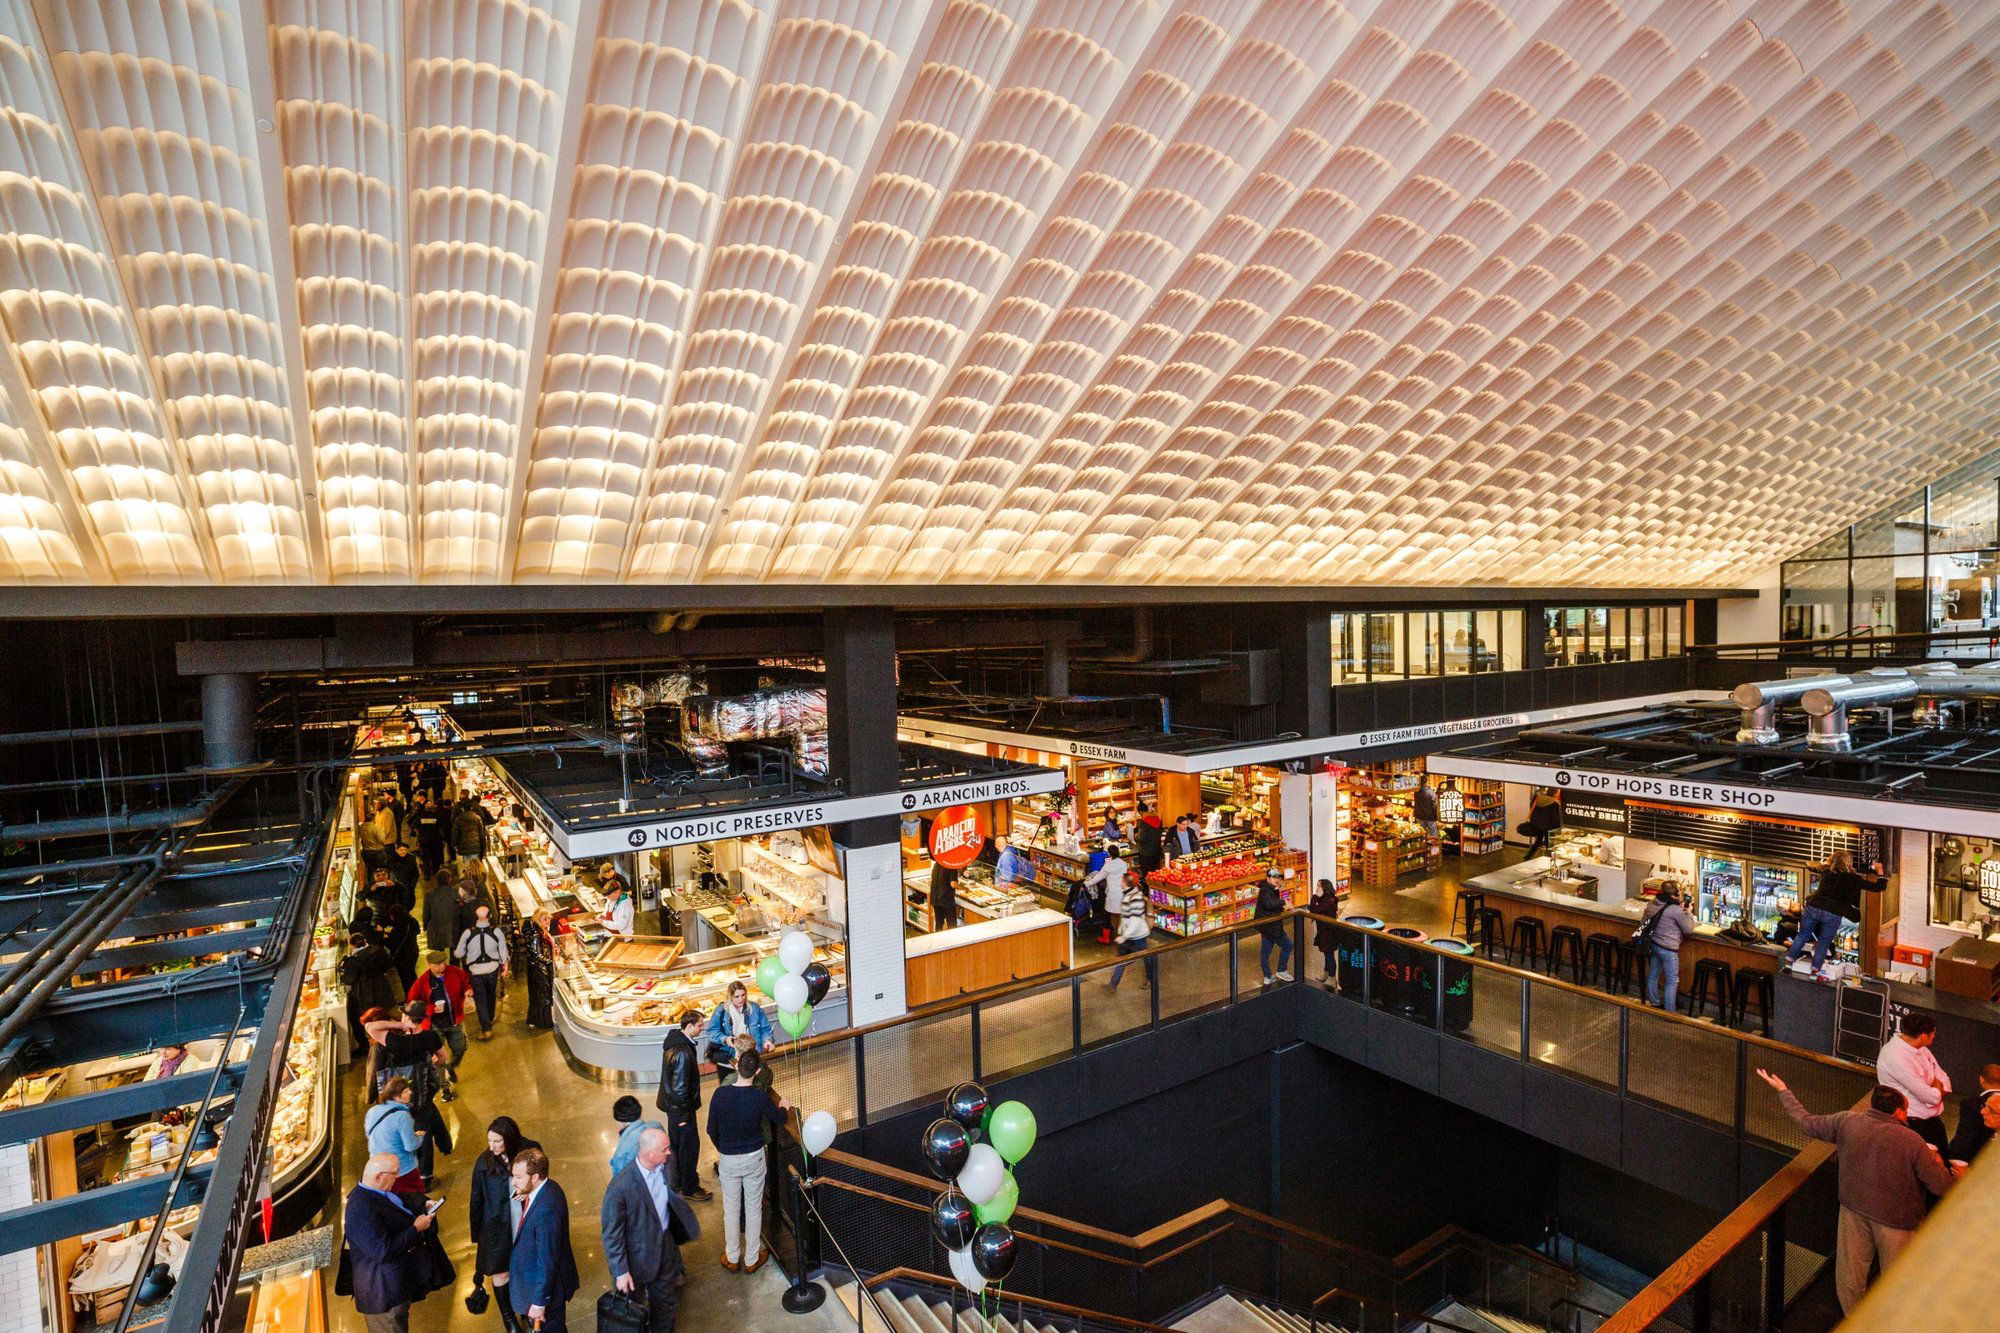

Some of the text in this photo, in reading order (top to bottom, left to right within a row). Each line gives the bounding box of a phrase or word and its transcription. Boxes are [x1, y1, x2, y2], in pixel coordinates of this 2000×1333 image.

[1370, 732, 1391, 744] ESSEX
[1393, 729, 1412, 740] FARM
[1414, 726, 1438, 737] FRUITS,
[1439, 720, 1477, 734] VEGETABLES
[1477, 720, 1482, 729] &
[1483, 716, 1514, 728] GROCERIES
[1080, 745, 1102, 757] ESSEX
[1104, 748, 1126, 761] FARM
[903, 780, 1030, 807] 42 ARANCINI BROS.
[1442, 791, 1460, 799] TOP
[1557, 774, 1775, 807] 45 TOP HOPS BEER SHOP
[1439, 799, 1464, 811] HOPS
[1566, 807, 1625, 823] GREAT BEER
[630, 807, 823, 844] 43 NORDIC PRESERVES
[934, 817, 976, 855] ARANCINI
[1986, 860, 2000, 873] TO
[1980, 868, 2000, 890] HO
